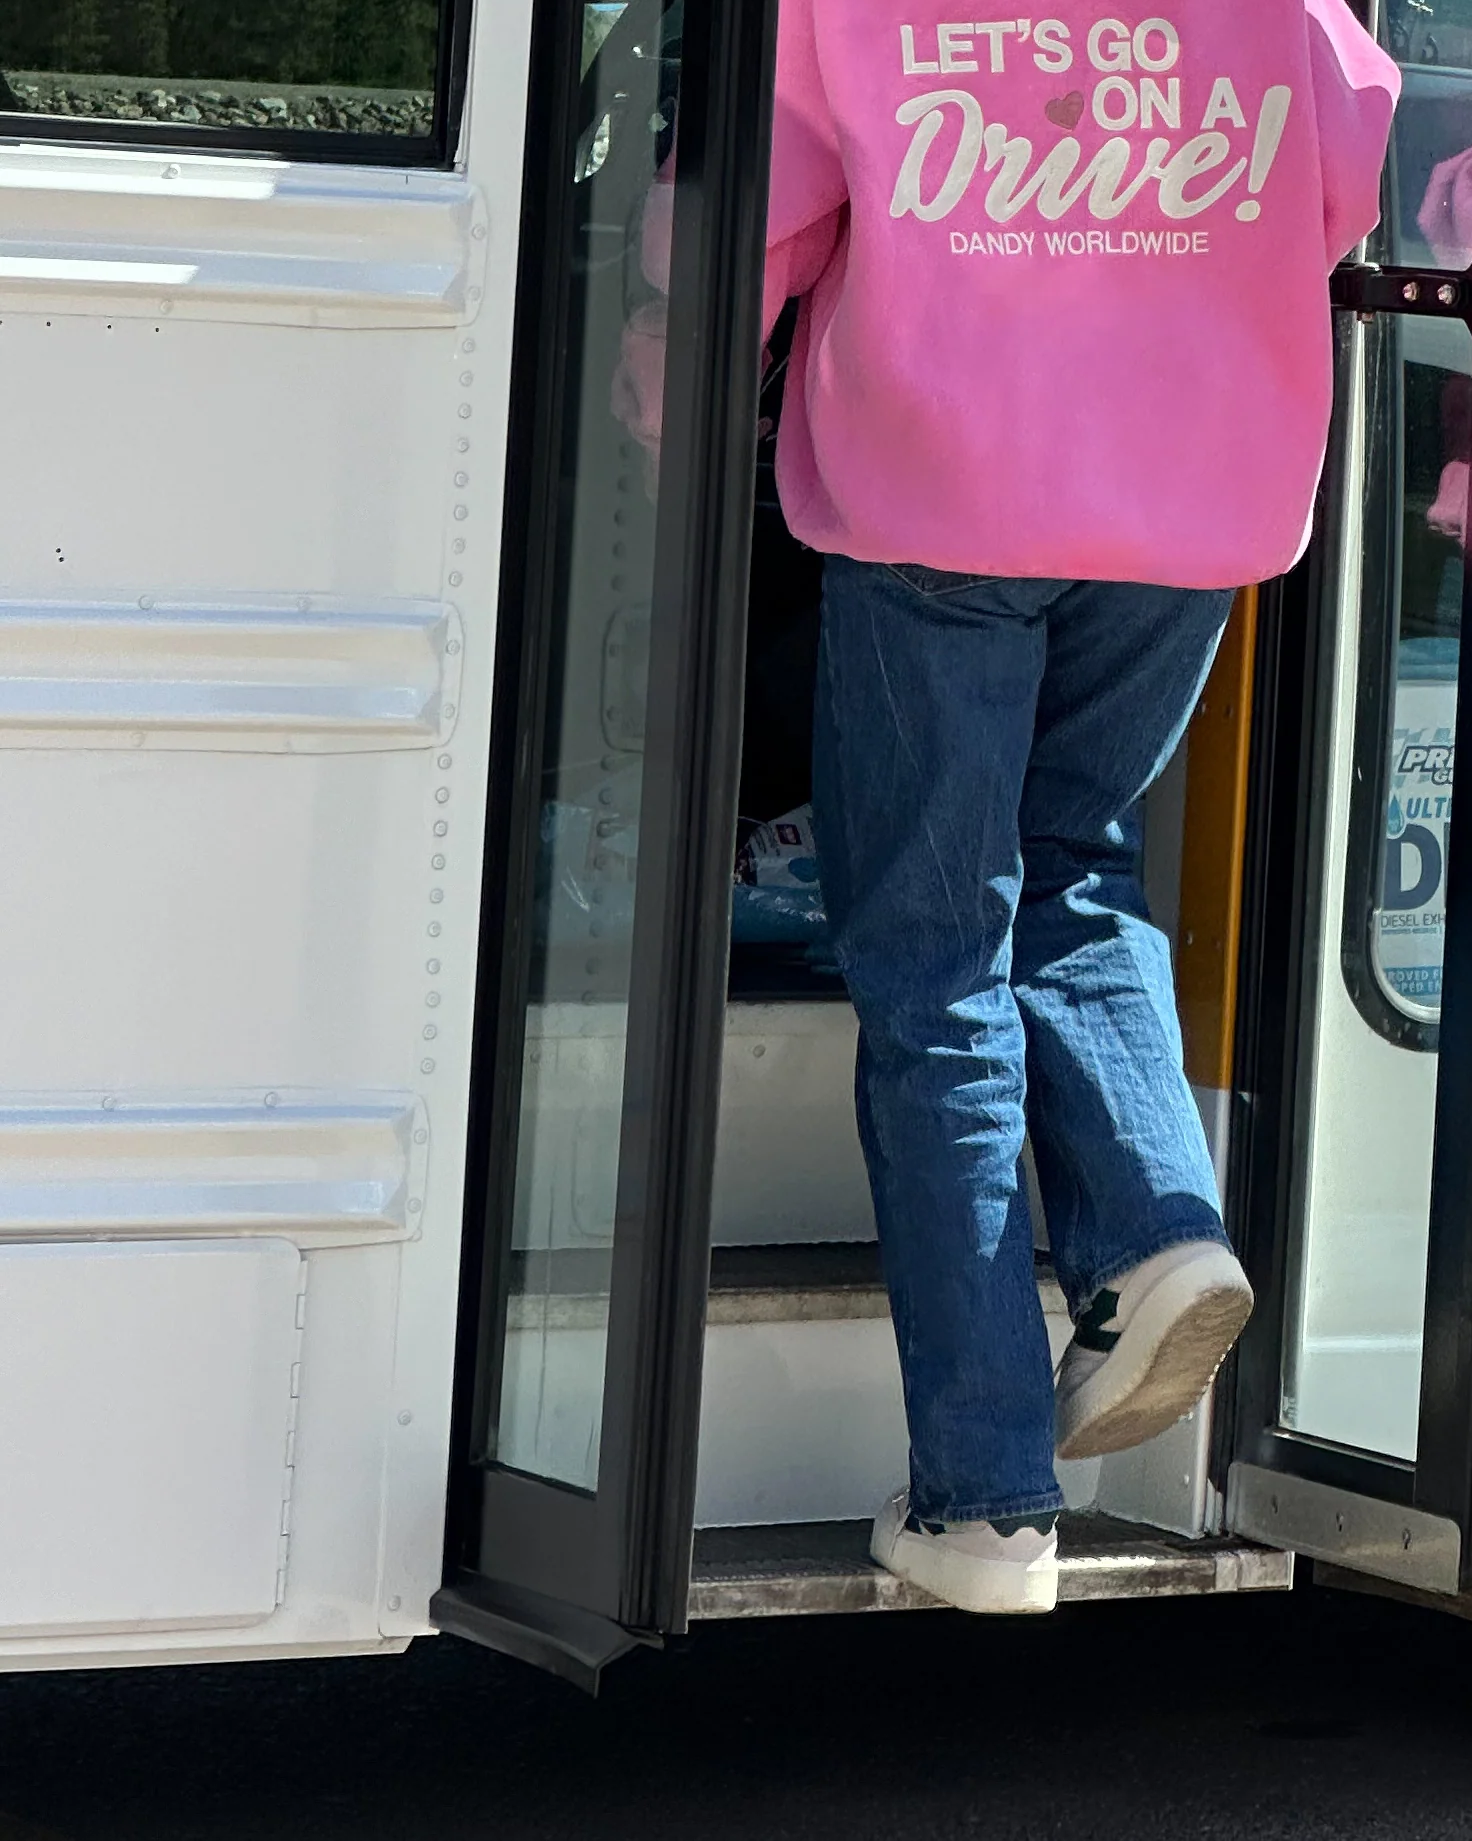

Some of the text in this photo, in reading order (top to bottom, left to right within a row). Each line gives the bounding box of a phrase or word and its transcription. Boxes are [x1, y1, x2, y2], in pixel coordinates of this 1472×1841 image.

[900, 17, 1180, 75] LET'S GO
[1091, 75, 1248, 131] ON A
[889, 84, 1292, 224] Drive!
[949, 229, 1211, 257] DANDY WORLDWIDE
[1380, 914, 1420, 929] DIESEL
